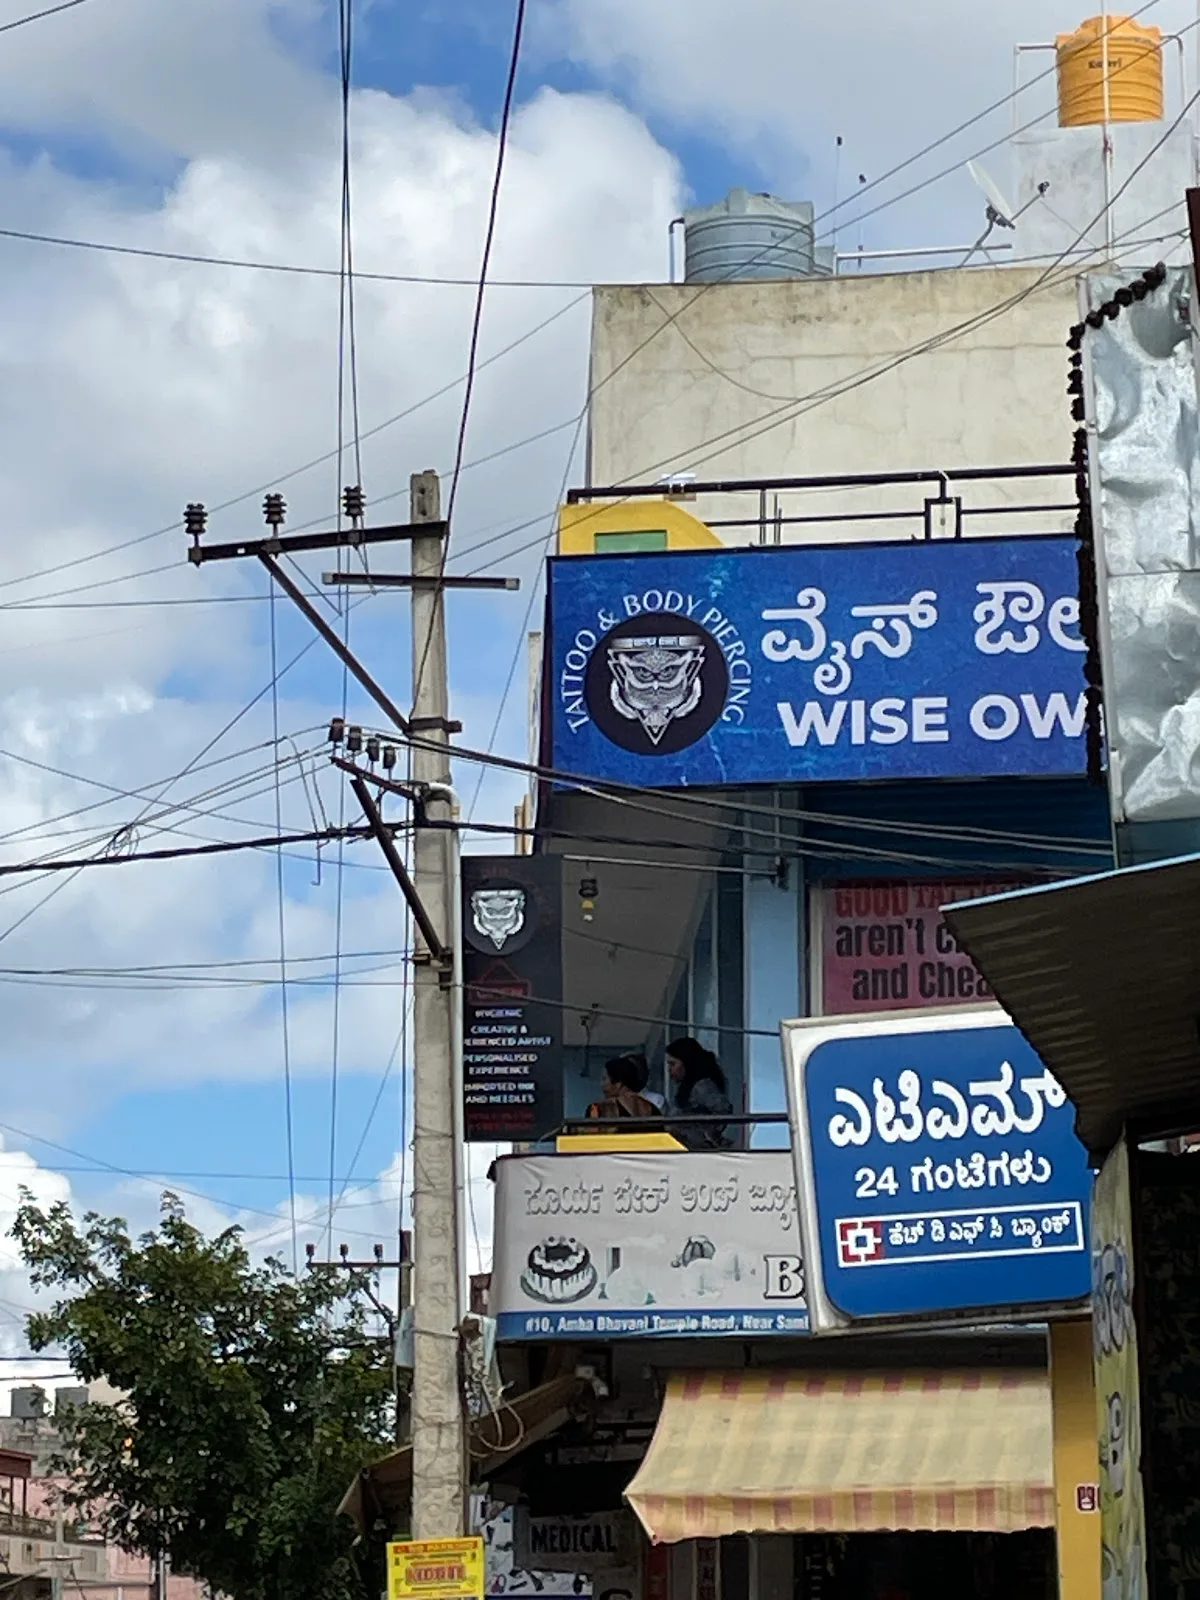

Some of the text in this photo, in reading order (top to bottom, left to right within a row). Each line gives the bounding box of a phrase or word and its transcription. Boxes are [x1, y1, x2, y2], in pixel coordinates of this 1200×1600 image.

[761, 581, 1090, 695] ವೈಸ್ ಔಲ
[560, 589, 752, 734] TATTOO & BODY PIERCING
[776, 692, 1104, 747] WISE OW
[836, 918, 924, 957] aren't
[852, 961, 994, 1000] and Chea
[464, 1038, 516, 1046] ERIENCED
[855, 1149, 1052, 1198] 24 ಗಂಟೆಗಳು
[763, 1254, 805, 1299] B
[652, 1315, 699, 1332] Temple
[701, 1314, 739, 1331] Road,
[742, 1314, 773, 1329] Near
[531, 1524, 618, 1553] MEDICAL
